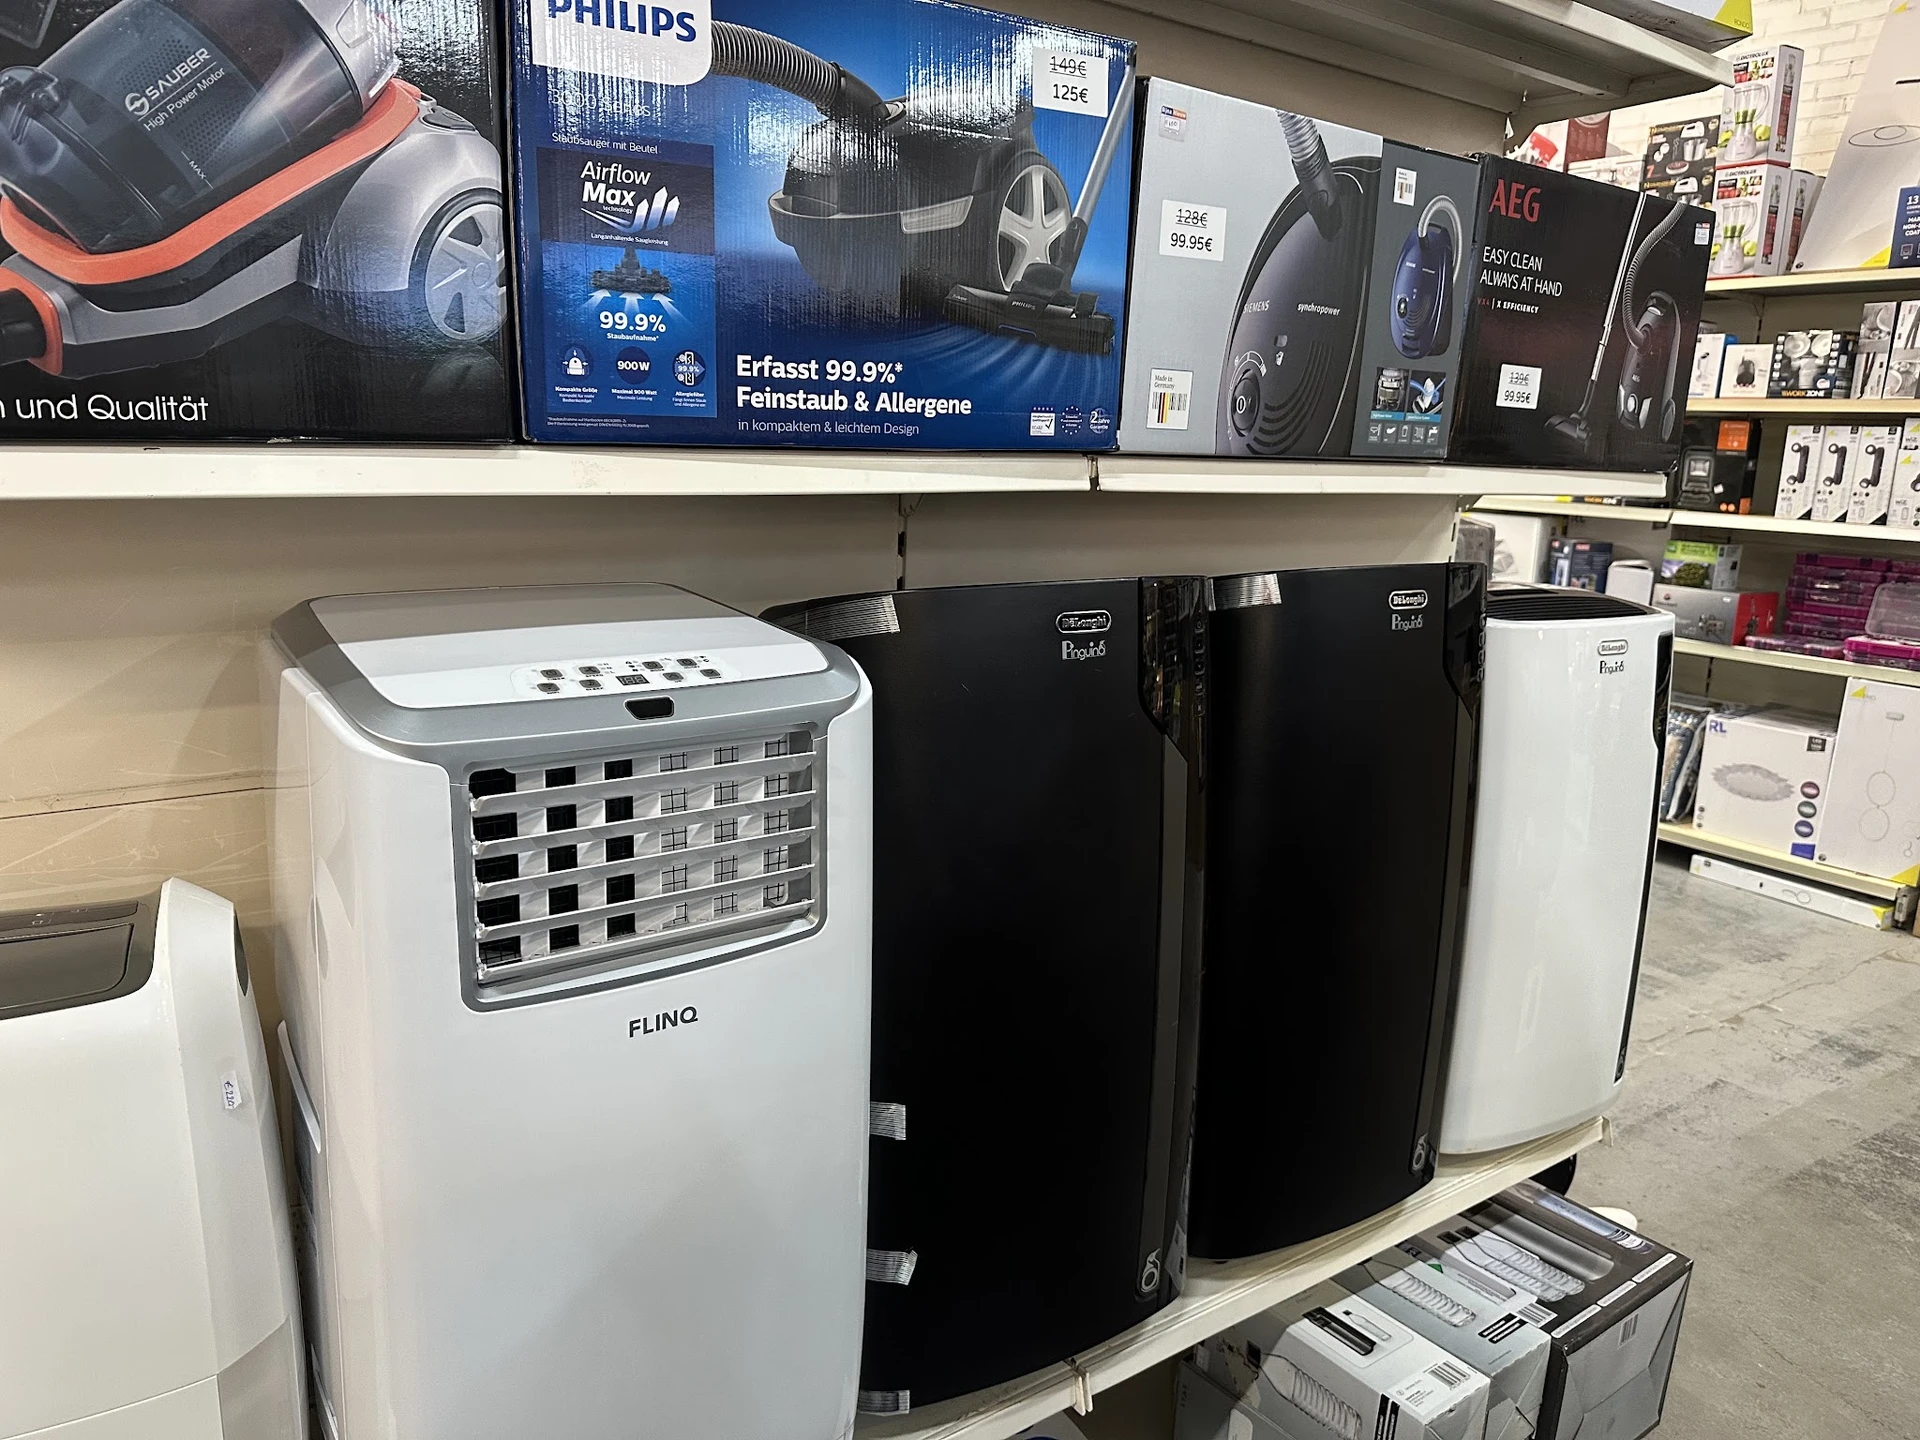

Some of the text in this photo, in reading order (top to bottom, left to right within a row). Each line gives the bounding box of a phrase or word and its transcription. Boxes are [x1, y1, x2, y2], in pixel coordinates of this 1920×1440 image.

[548, 0, 697, 42] PHILIPS
[145, 47, 212, 100] SAUBER
[1049, 55, 1087, 77] 149€
[143, 67, 225, 131] High Power Motor
[1053, 83, 1088, 104] 125€
[551, 131, 659, 155] Staubsauger mit Beutel
[188, 160, 207, 180] MAX
[580, 160, 652, 186] Airflow
[582, 181, 637, 207] Max
[1488, 178, 1542, 223] AEG
[1906, 195, 1919, 205] 13
[602, 205, 634, 214] technology
[1176, 208, 1208, 228] 128€
[1170, 232, 1213, 252] 99.95€
[1483, 246, 1543, 272] EASY CLEAN
[1480, 269, 1562, 297] ALWAYS AT HAND
[1243, 300, 1270, 314] SIEMENS
[1297, 302, 1341, 316] synchropower
[1496, 300, 1502, 308] X
[1503, 301, 1539, 314] EFFICIENCY
[600, 310, 667, 333] 99.9%
[736, 354, 819, 380] Erfasst
[1153, 381, 1175, 390] Germany
[1504, 389, 1531, 404] 99.95€
[16, 394, 78, 419] und
[88, 394, 208, 421] Qualität
[736, 385, 972, 418] Feinstaub & Allergene
[738, 419, 919, 436] in kompaktem & leichtem Design
[1708, 719, 1727, 734] RL
[629, 1006, 699, 1038] FLINQ
